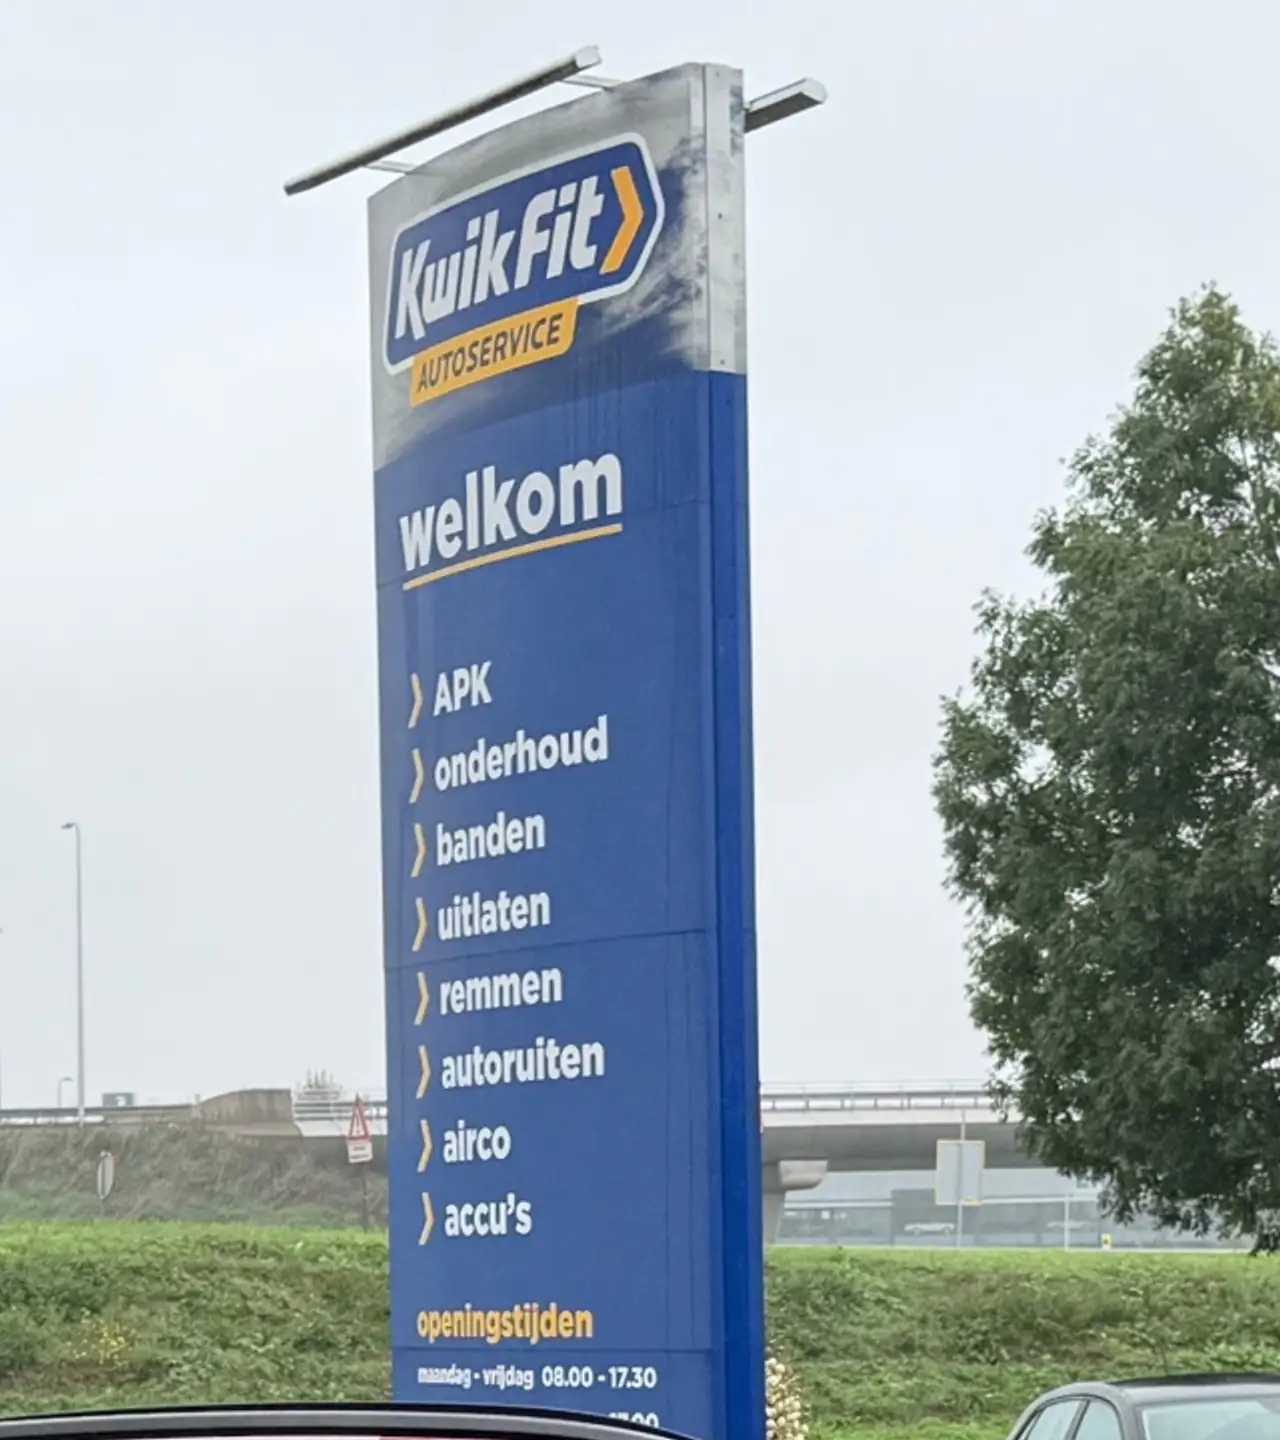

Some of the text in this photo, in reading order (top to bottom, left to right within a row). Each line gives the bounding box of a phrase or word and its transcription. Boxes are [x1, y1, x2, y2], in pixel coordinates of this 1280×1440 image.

[417, 312, 564, 393] AUTOSERVICE
[399, 453, 622, 571] welkom
[433, 661, 492, 717] APK
[434, 714, 609, 791] onderhoud
[436, 811, 545, 866] banden
[438, 890, 550, 941] uitlaten
[439, 967, 562, 1015] remmen
[441, 1036, 605, 1089] autoruiten
[443, 1119, 511, 1163] airco
[444, 1192, 532, 1237] accu's
[417, 1302, 593, 1345] openingstijden
[417, 1363, 472, 1390] maandag
[482, 1364, 534, 1391] vrijdag
[541, 1365, 594, 1388] 08.00
[608, 1366, 657, 1389] 17.30
